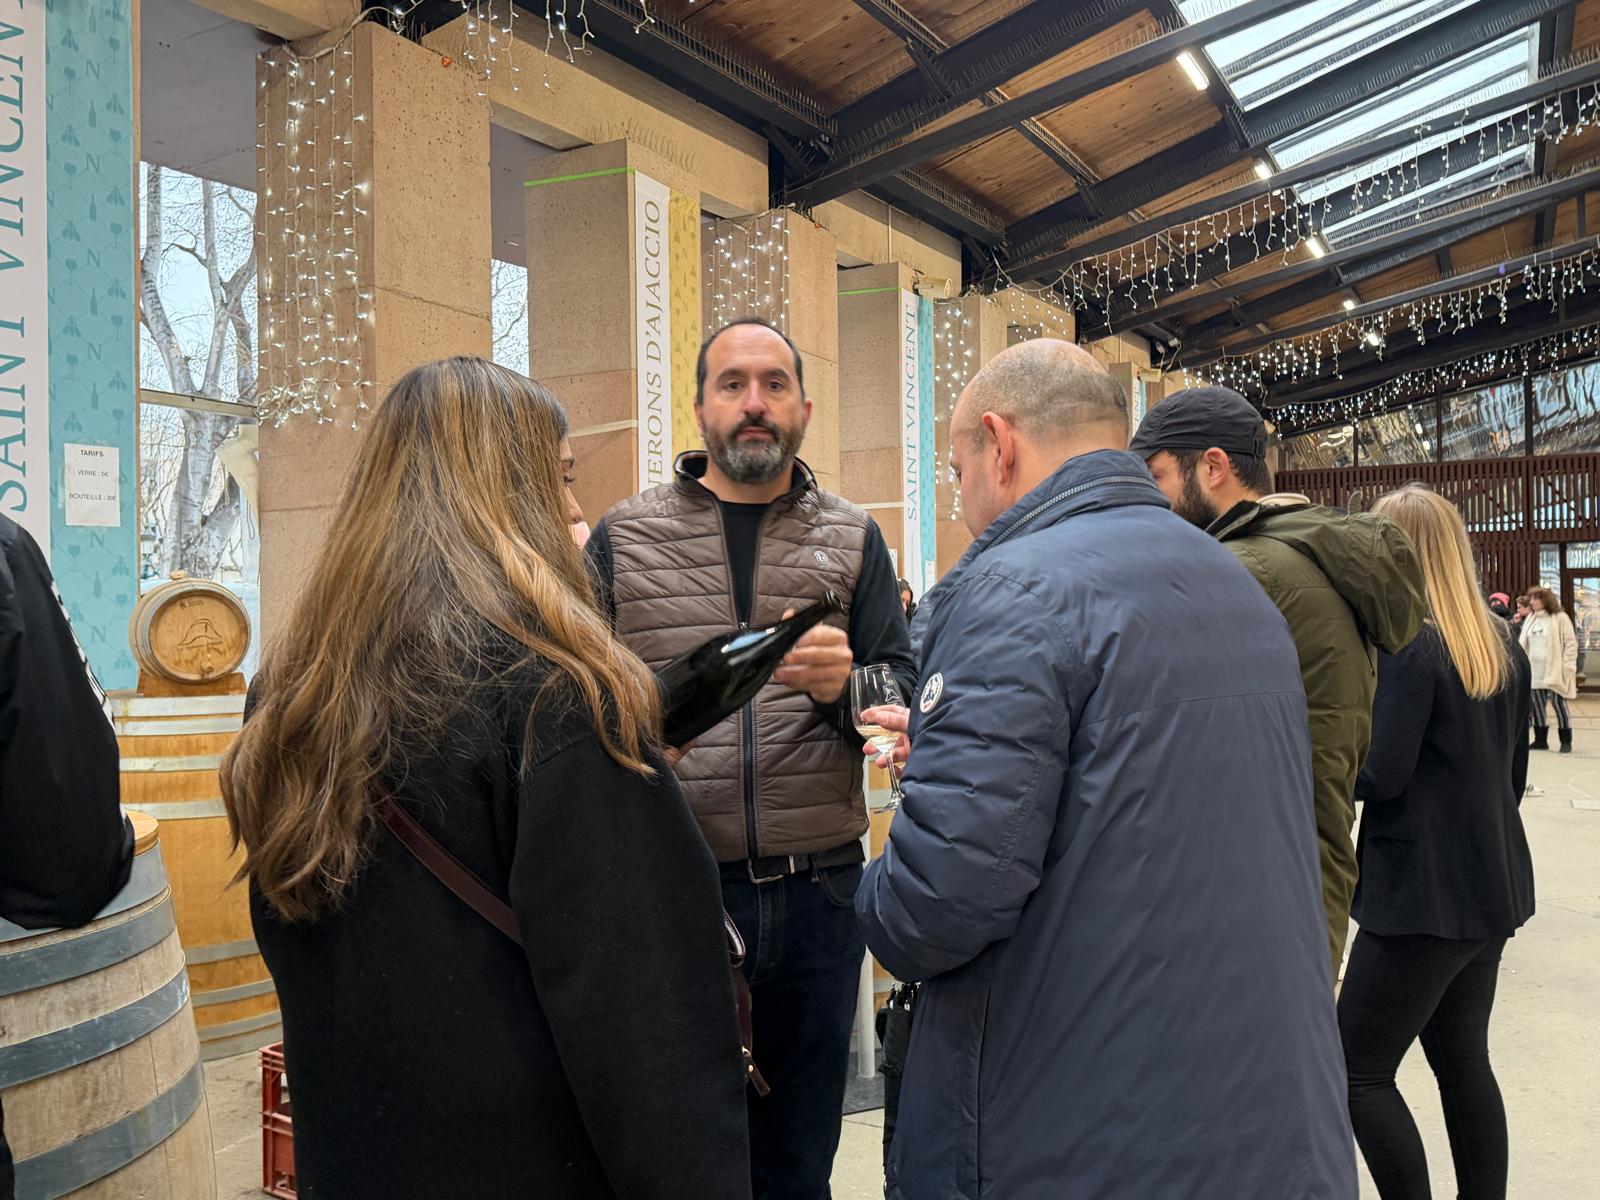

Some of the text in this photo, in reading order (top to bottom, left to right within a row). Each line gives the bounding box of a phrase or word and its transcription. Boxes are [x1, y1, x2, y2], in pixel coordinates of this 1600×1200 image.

[0, 0, 25, 271] VINCEN
[644, 200, 664, 364] D'AJACCIO
[905, 303, 917, 429] VINCENT
[69, 492, 102, 501] BOUTEILLE
[80, 449, 104, 458] TARIFS
[906, 436, 917, 521] SAINT
